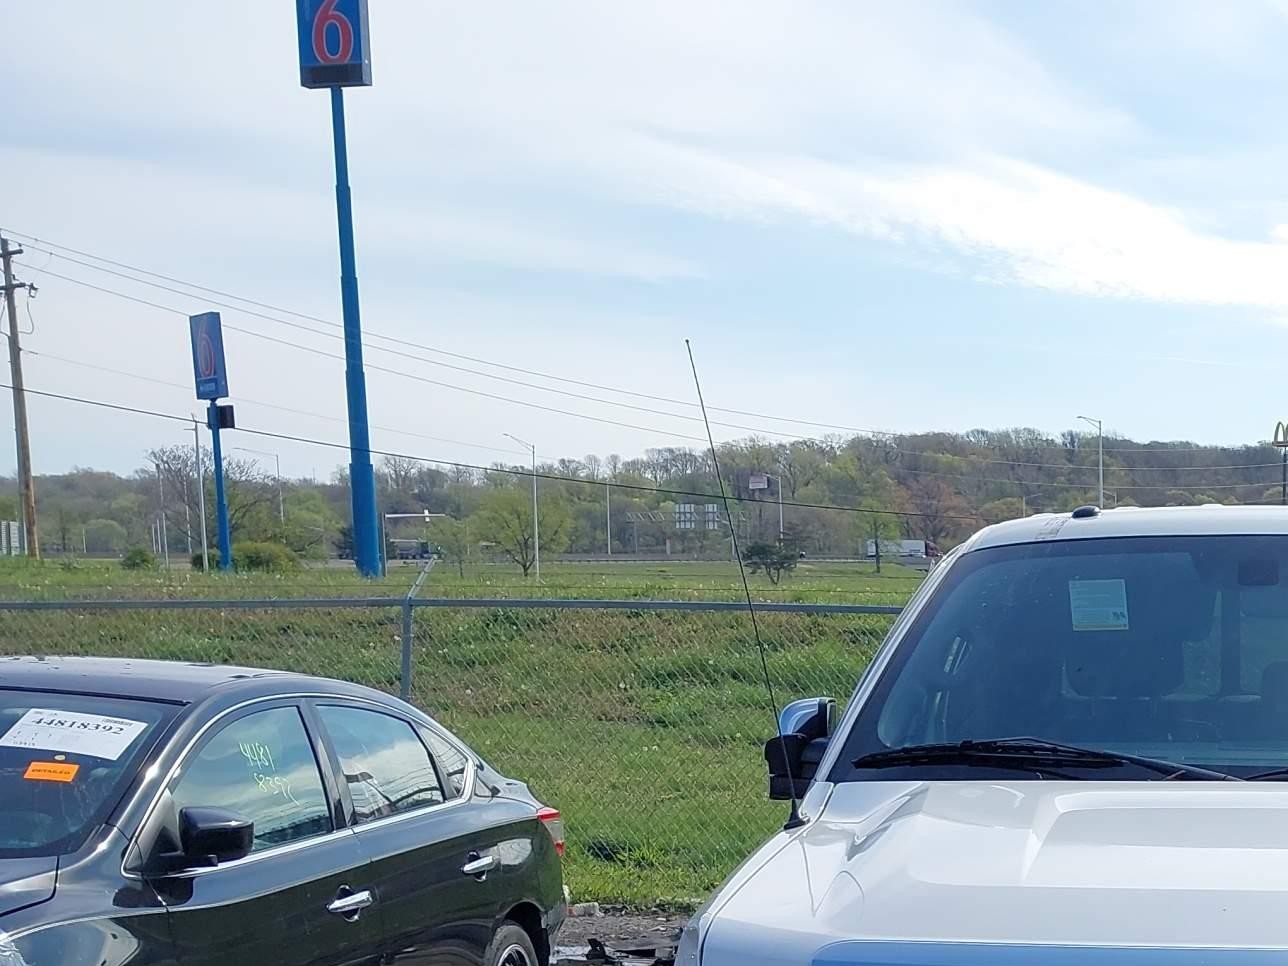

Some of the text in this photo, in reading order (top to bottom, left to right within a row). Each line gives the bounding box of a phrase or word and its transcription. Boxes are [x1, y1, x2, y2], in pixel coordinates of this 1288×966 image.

[312, 0, 353, 64] 6
[198, 318, 215, 379] 6
[32, 718, 125, 735] 44818392
[239, 742, 275, 773] 4481
